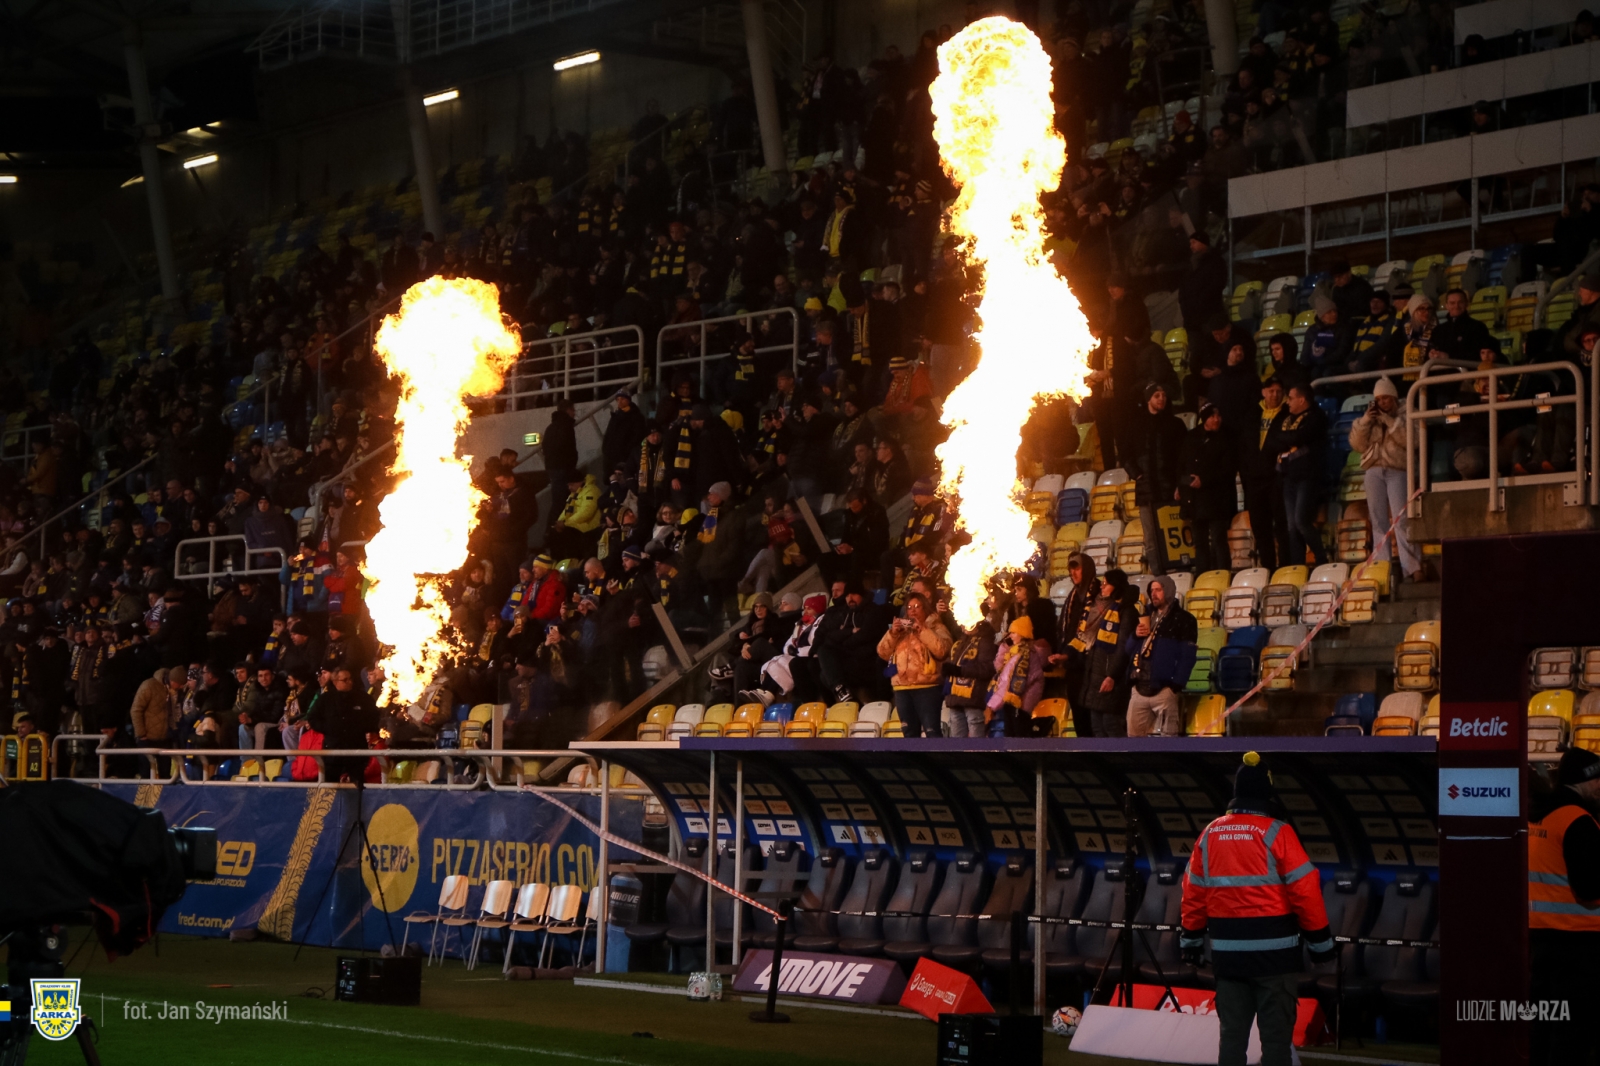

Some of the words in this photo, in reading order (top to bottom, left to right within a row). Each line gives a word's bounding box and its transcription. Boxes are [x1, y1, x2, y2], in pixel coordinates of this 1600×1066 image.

[1167, 526, 1194, 549] 50
[1449, 716, 1509, 737] Betclic
[29, 762, 39, 772] A2
[1462, 787, 1511, 798] SUZUKI
[1209, 824, 1251, 834] ZABEZPIECZENIE
[1219, 833, 1233, 841] ARKA
[1233, 833, 1254, 841] GDYNIA
[370, 844, 411, 873] SERIO
[610, 891, 640, 904] 4MOVE
[753, 957, 874, 998] 4MOVE
